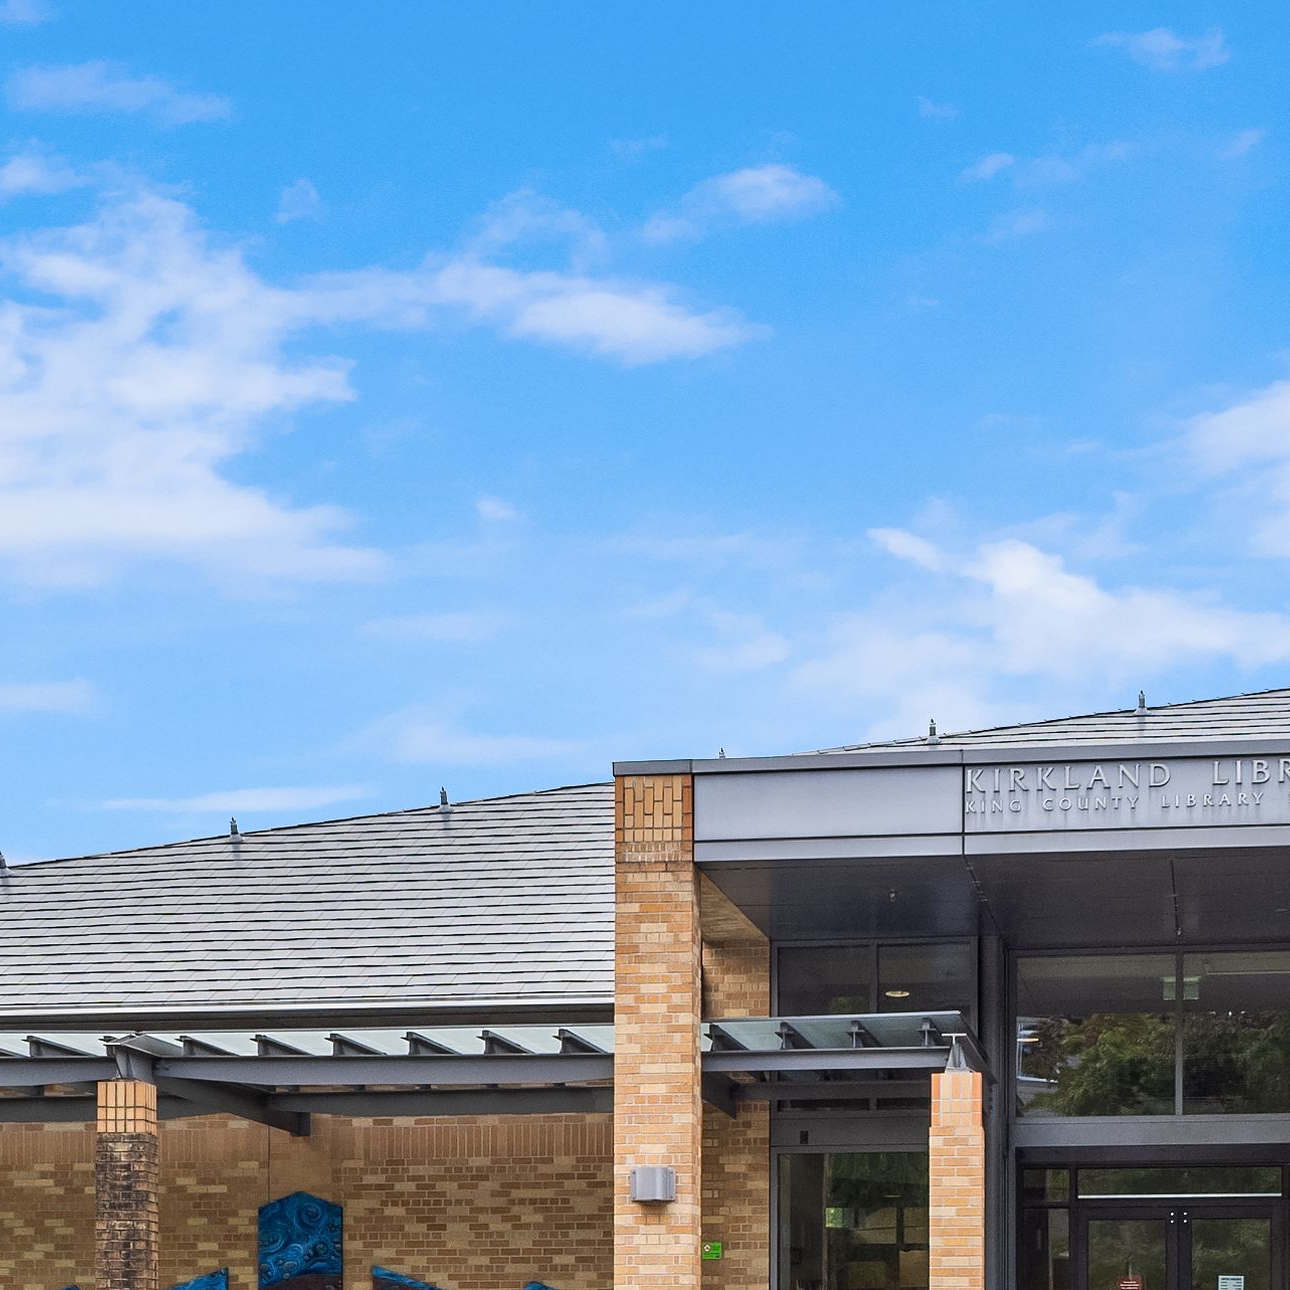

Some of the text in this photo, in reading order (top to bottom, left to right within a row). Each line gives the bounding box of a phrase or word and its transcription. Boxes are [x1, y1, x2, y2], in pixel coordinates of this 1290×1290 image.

[966, 763, 1172, 793] KIRKLAND
[966, 799, 1021, 814] KING
[1042, 796, 1139, 811] COUNTY
[1161, 792, 1263, 808] LIBRARY
